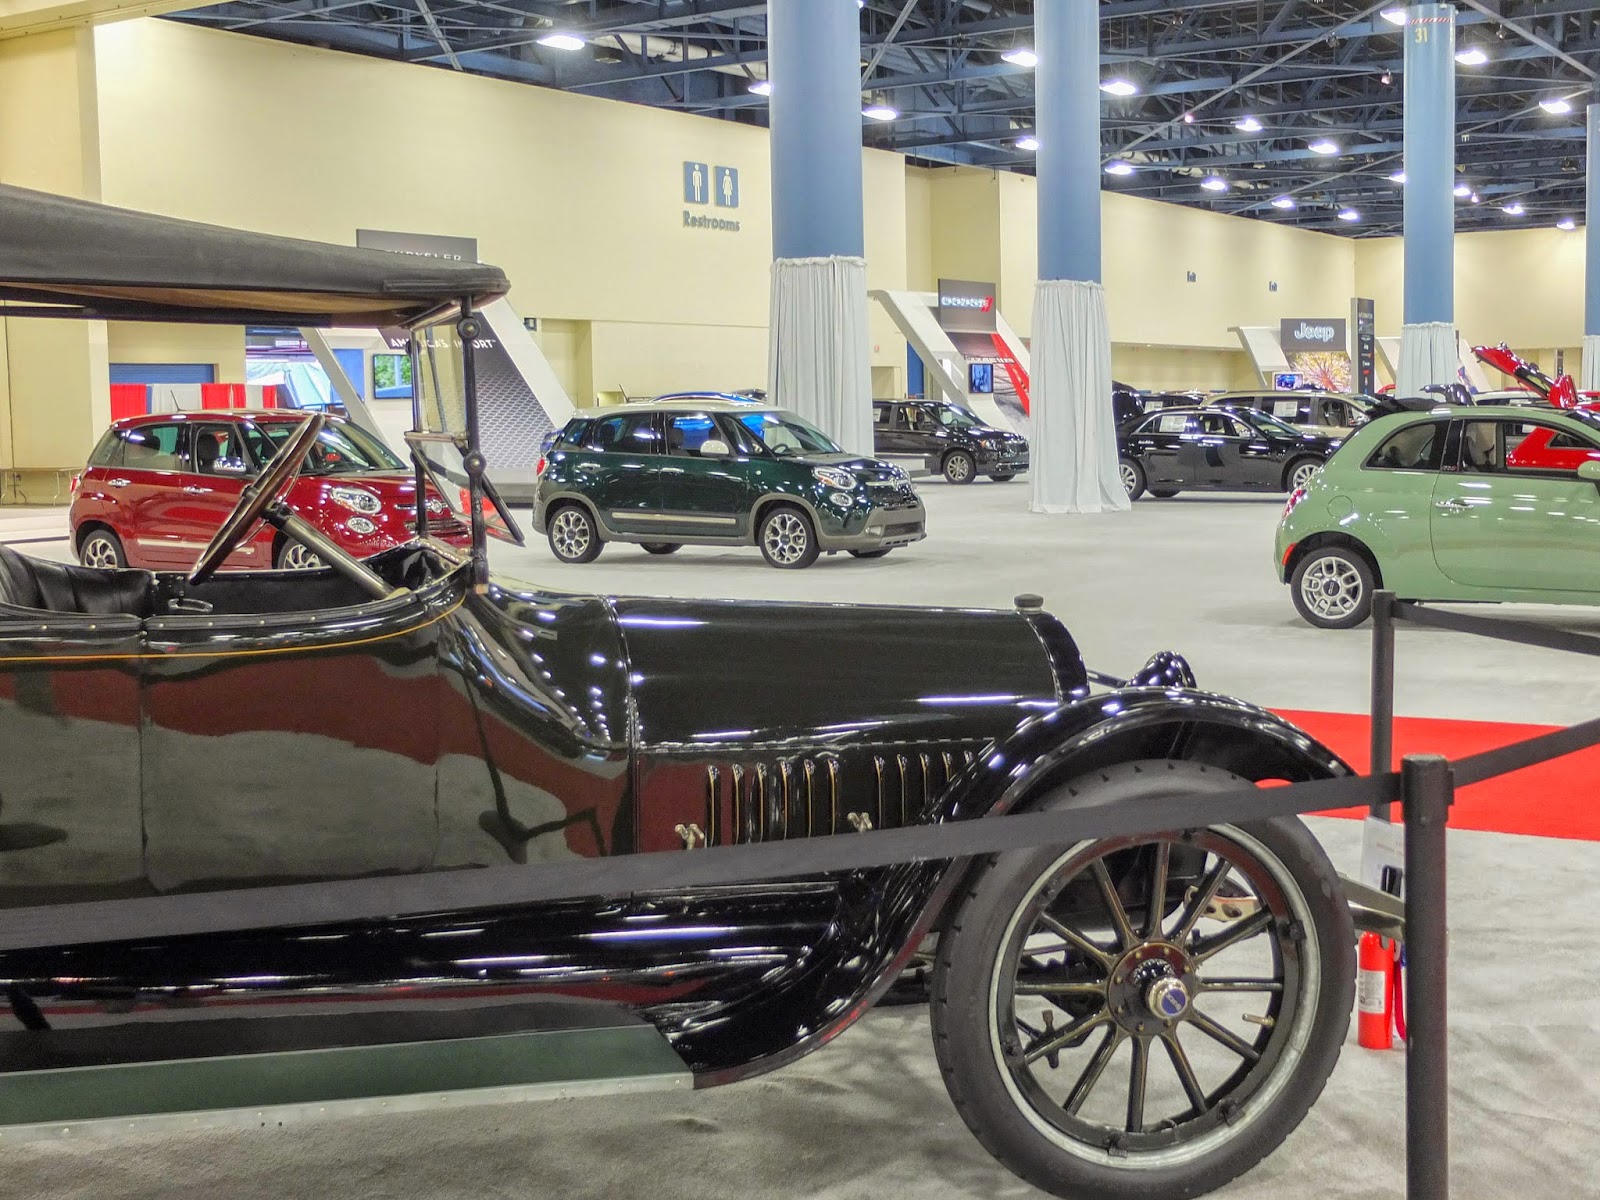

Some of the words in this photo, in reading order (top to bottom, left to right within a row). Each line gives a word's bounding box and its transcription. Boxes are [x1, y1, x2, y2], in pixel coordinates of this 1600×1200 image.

[1415, 27, 1428, 43] 31
[683, 210, 740, 232] Restrooms
[1294, 321, 1335, 342] Jeep
